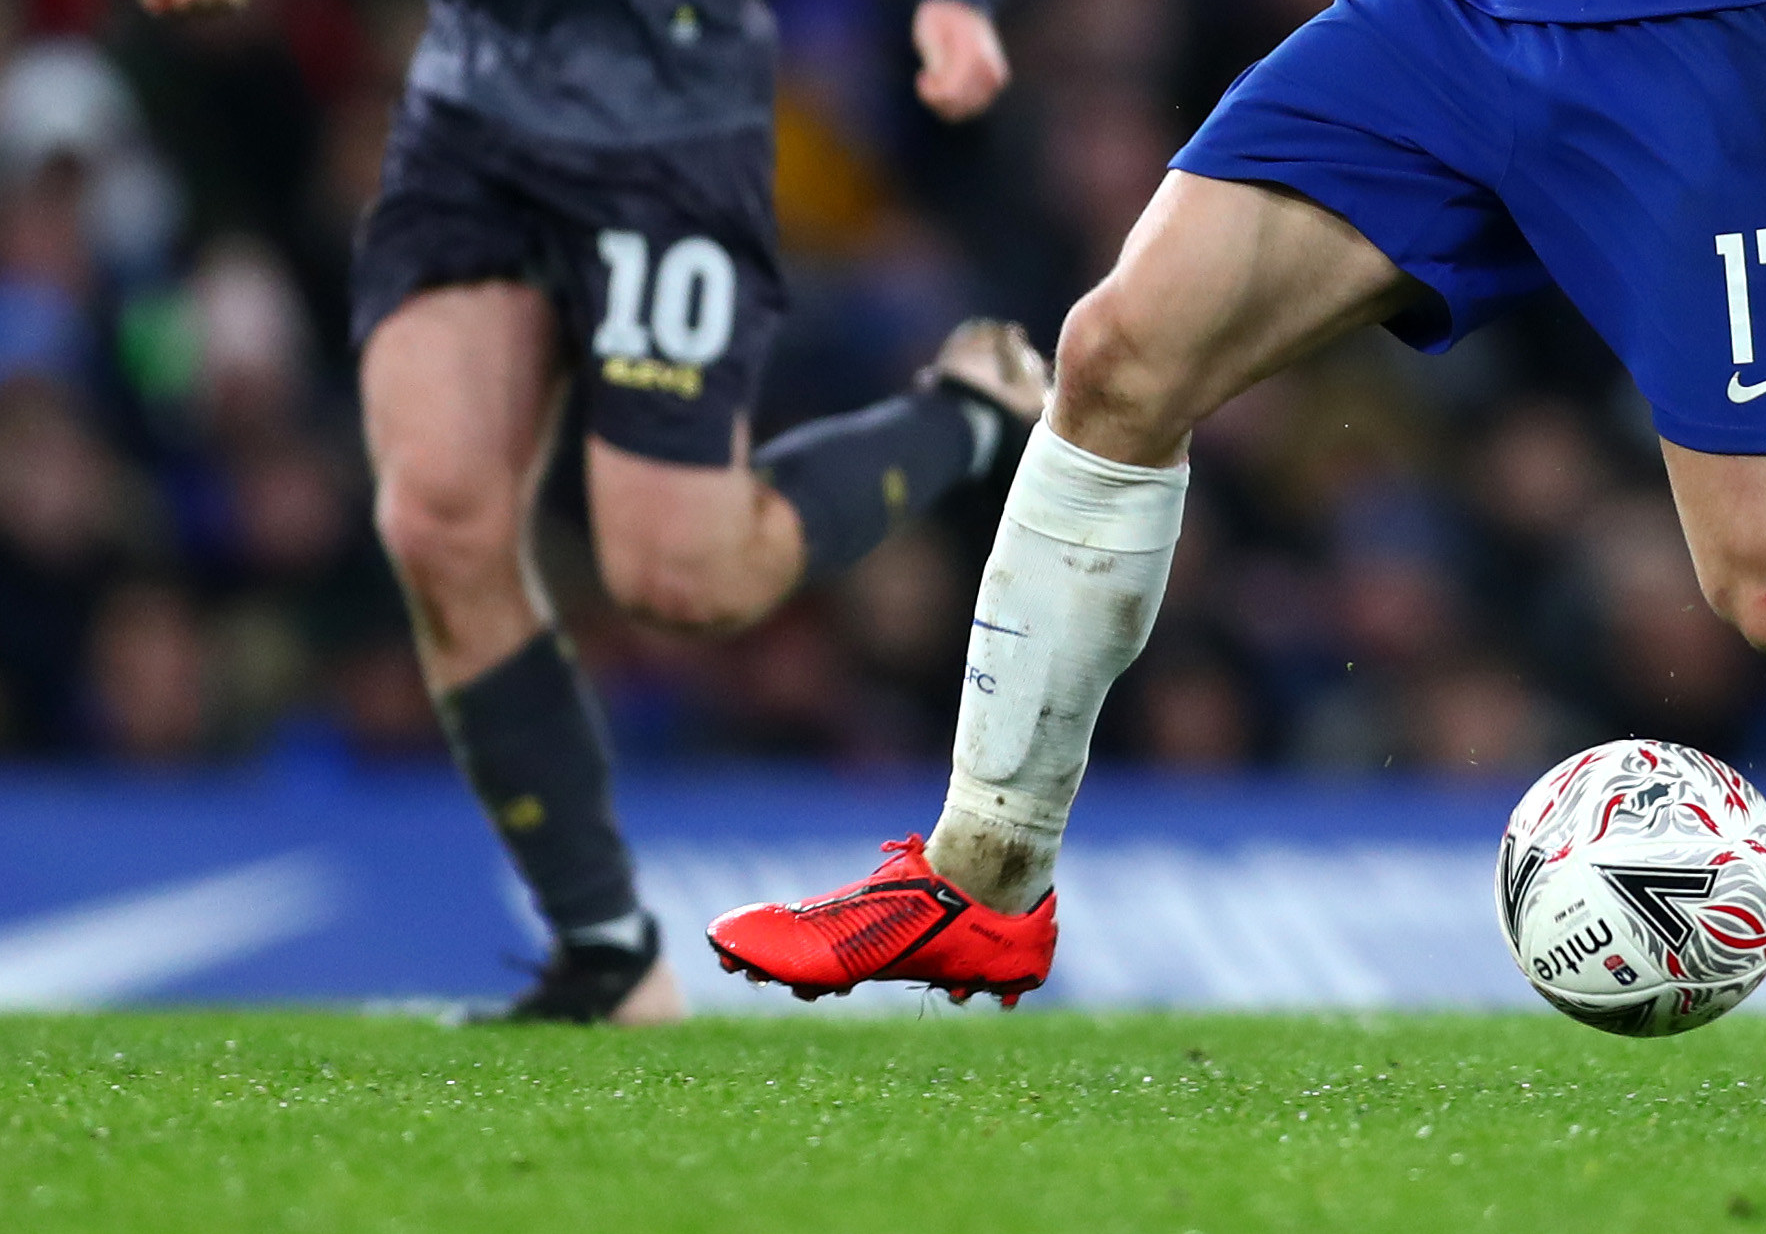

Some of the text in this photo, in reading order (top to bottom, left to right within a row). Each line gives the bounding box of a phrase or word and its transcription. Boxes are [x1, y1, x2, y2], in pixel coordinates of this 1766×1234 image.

[592, 228, 737, 368] 10
[966, 662, 996, 695] FC
[1533, 917, 1613, 981] mitre
